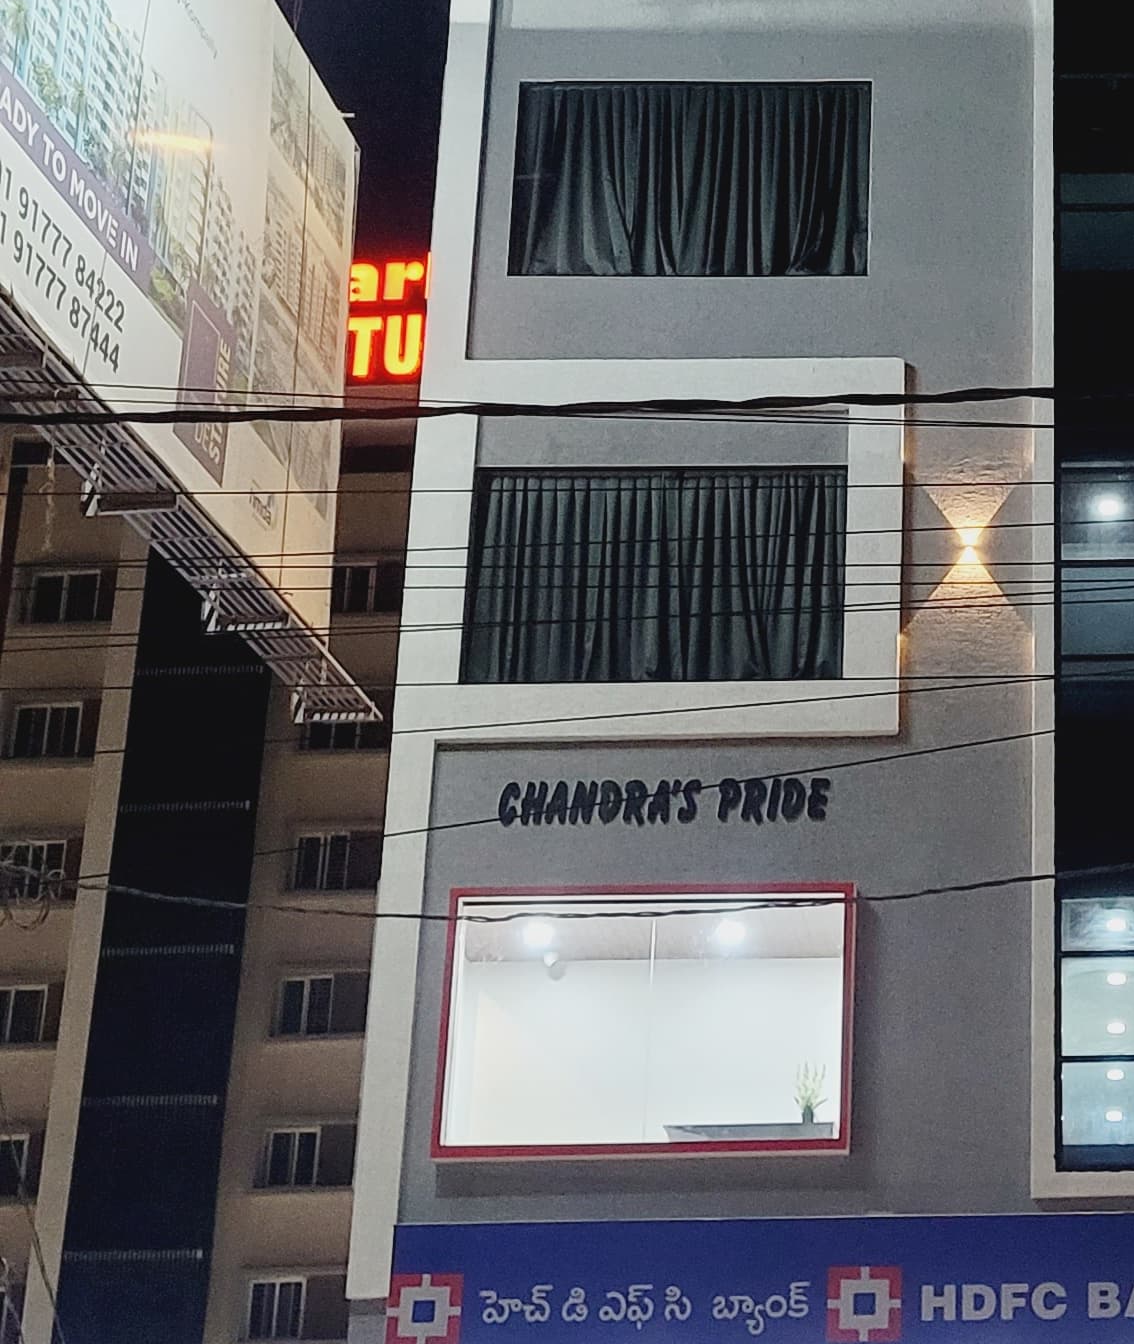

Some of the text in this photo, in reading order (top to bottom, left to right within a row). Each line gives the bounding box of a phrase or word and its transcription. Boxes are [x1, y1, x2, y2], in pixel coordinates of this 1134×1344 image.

[42, 135, 67, 182] TO
[70, 166, 119, 253] MOVE
[120, 231, 140, 272] IN
[13, 230, 67, 311] 91777
[69, 295, 121, 374] 87444
[18, 187, 73, 267] 91777
[75, 255, 127, 334] 84222
[499, 777, 832, 828] CHANDRA'S PRIDE
[562, 1286, 589, 1323] డి
[599, 1283, 654, 1330] ఎఫ్
[664, 1285, 693, 1322] సి
[712, 1281, 812, 1336] బ్యాంక్
[920, 1281, 1069, 1322] HDFC
